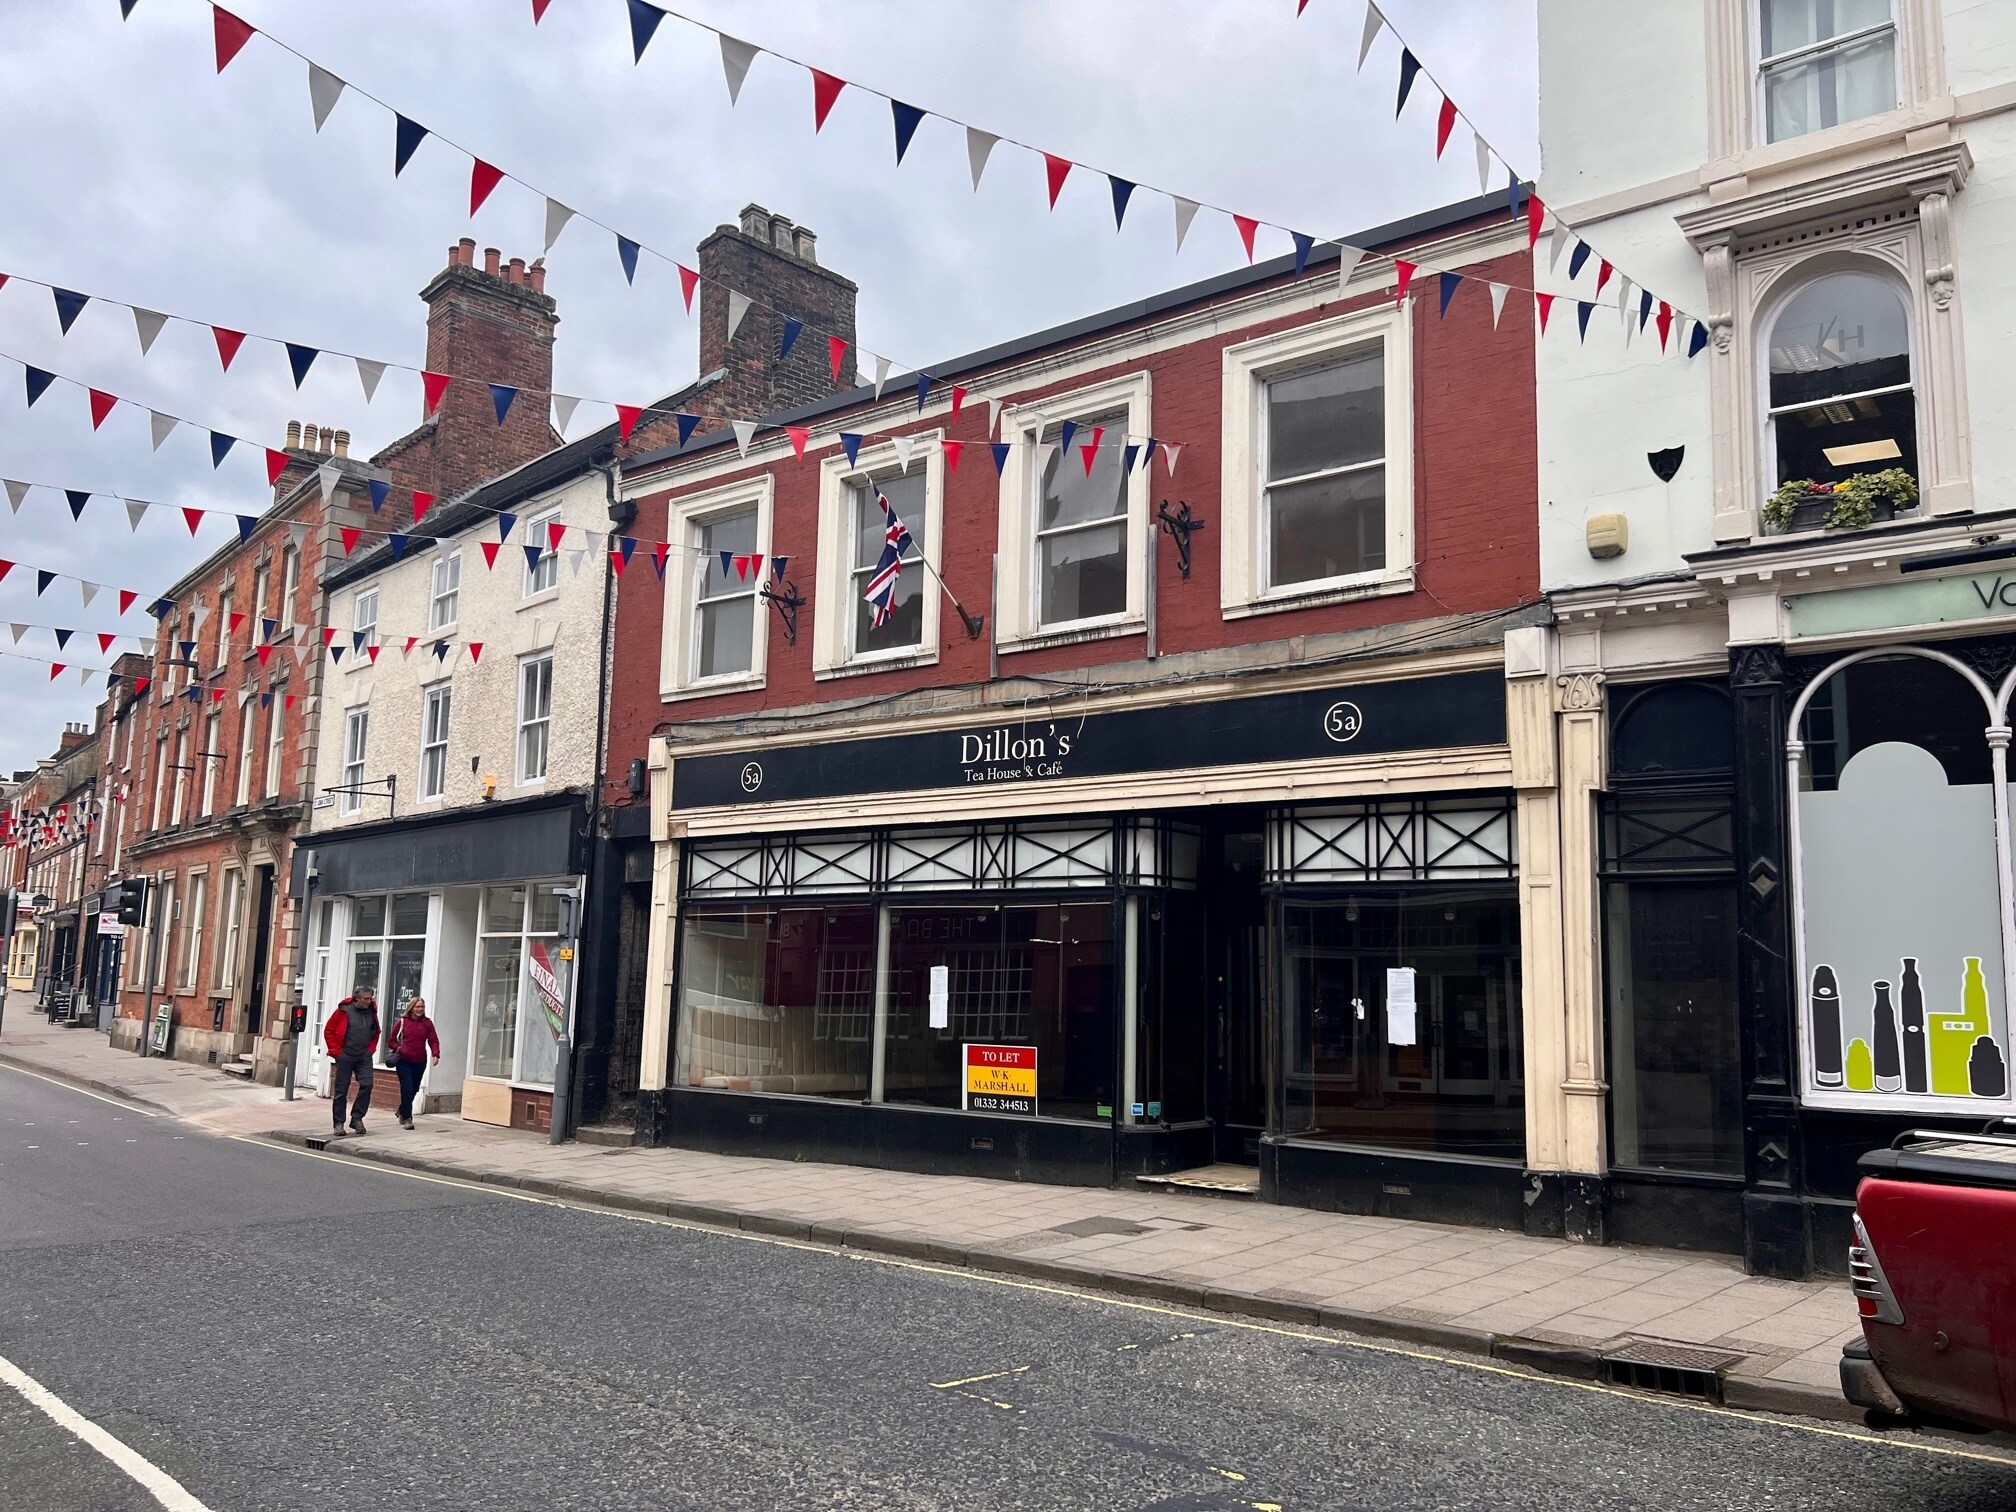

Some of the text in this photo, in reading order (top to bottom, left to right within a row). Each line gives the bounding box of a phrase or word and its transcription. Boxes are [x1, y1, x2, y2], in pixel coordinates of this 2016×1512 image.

[1330, 709, 1357, 732] 5a
[960, 724, 1070, 764] Dillon's
[744, 768, 760, 785] 5a
[964, 760, 1063, 782] Tea House & Café
[534, 964, 560, 997] FINAL
[400, 986, 414, 1000] Top
[982, 1051, 1020, 1063] TO LET
[973, 1080, 1029, 1093] MARSHALL
[974, 1097, 1029, 1112] 01332 344513
